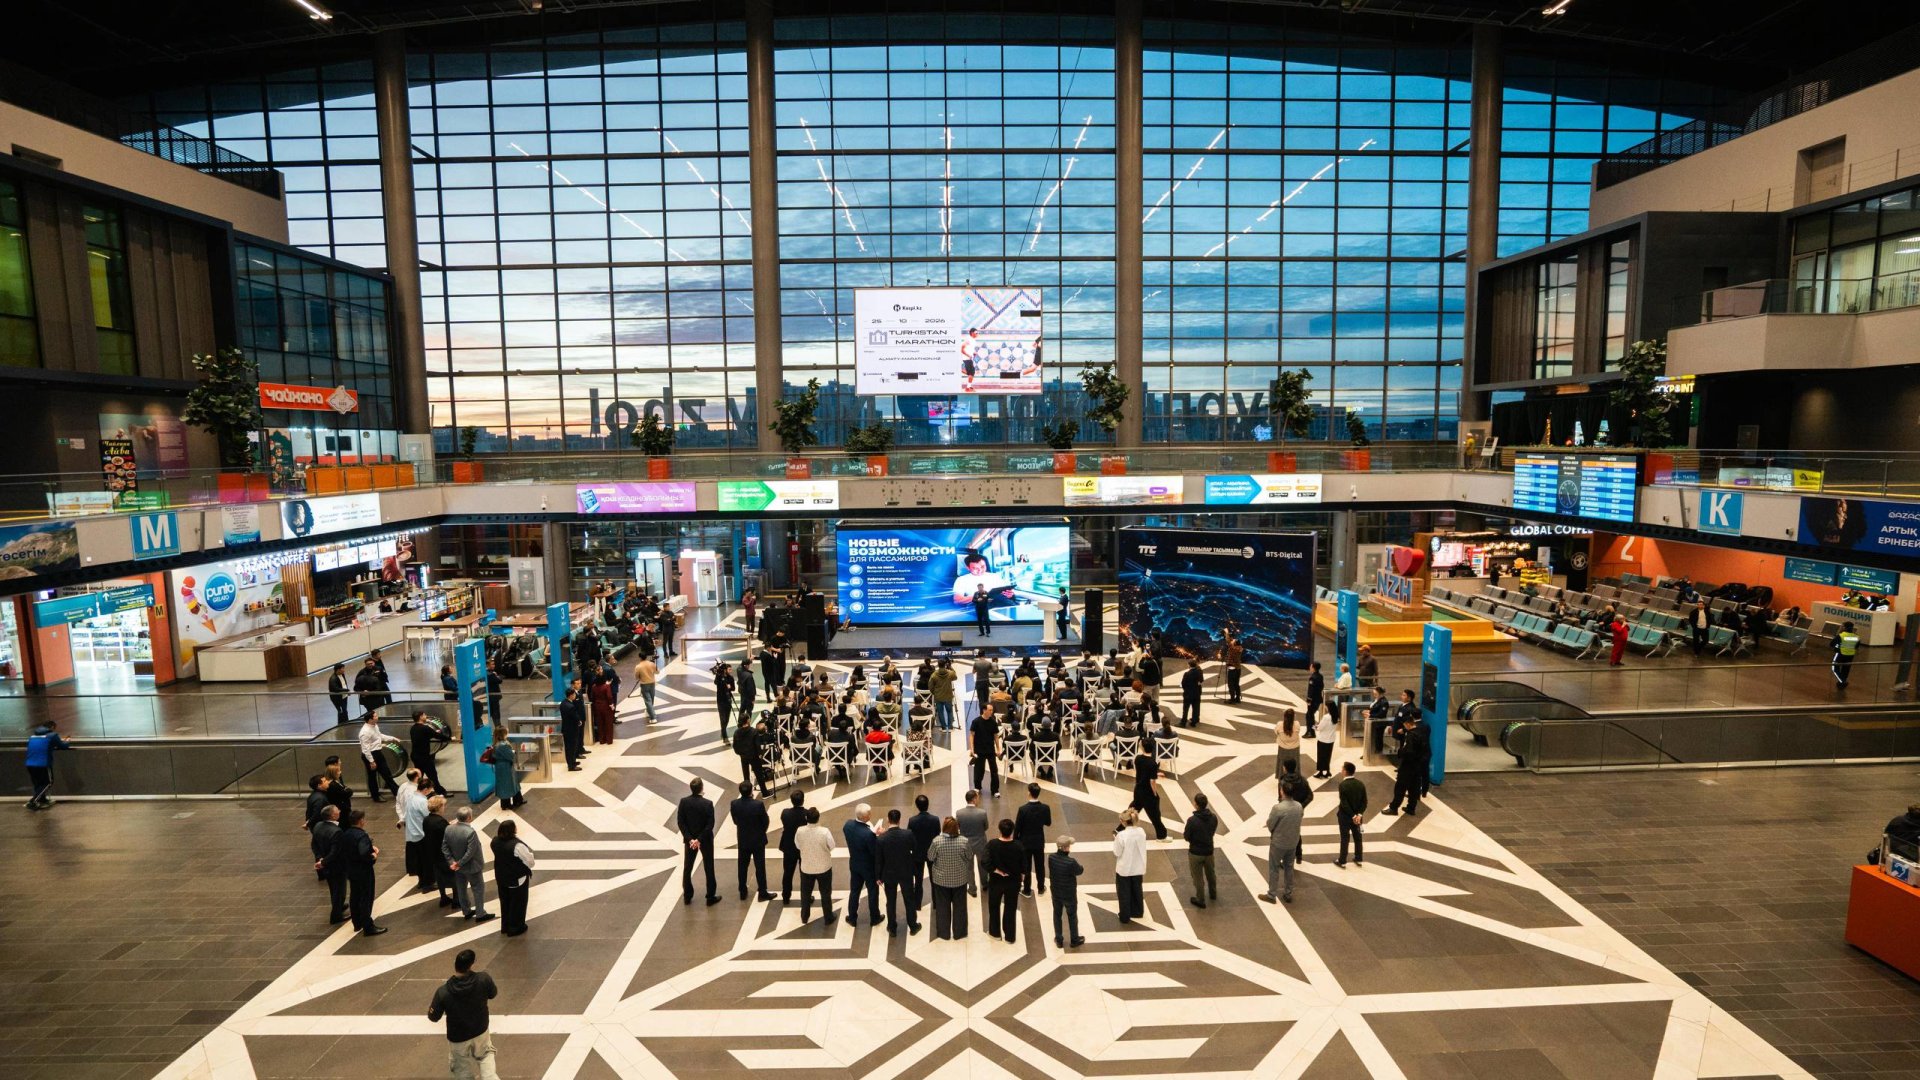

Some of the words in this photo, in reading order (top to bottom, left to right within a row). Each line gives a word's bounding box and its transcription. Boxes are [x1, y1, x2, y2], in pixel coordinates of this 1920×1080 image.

[1709, 493, 1731, 526] K
[140, 515, 171, 550] M
[1510, 525, 1552, 535] GLOBAL
[1881, 526, 1918, 536] АРТЫҚ
[849, 539, 899, 547] НОВЫЕ
[849, 547, 955, 556] ВОЗМОЖНОСТИ
[206, 582, 234, 600] punto
[1376, 569, 1412, 606] NZH
[561, 608, 565, 620] 3
[1824, 607, 1871, 621] ПОЛИЦИЯ
[1429, 630, 1434, 645] 4
[473, 646, 479, 660] 4
